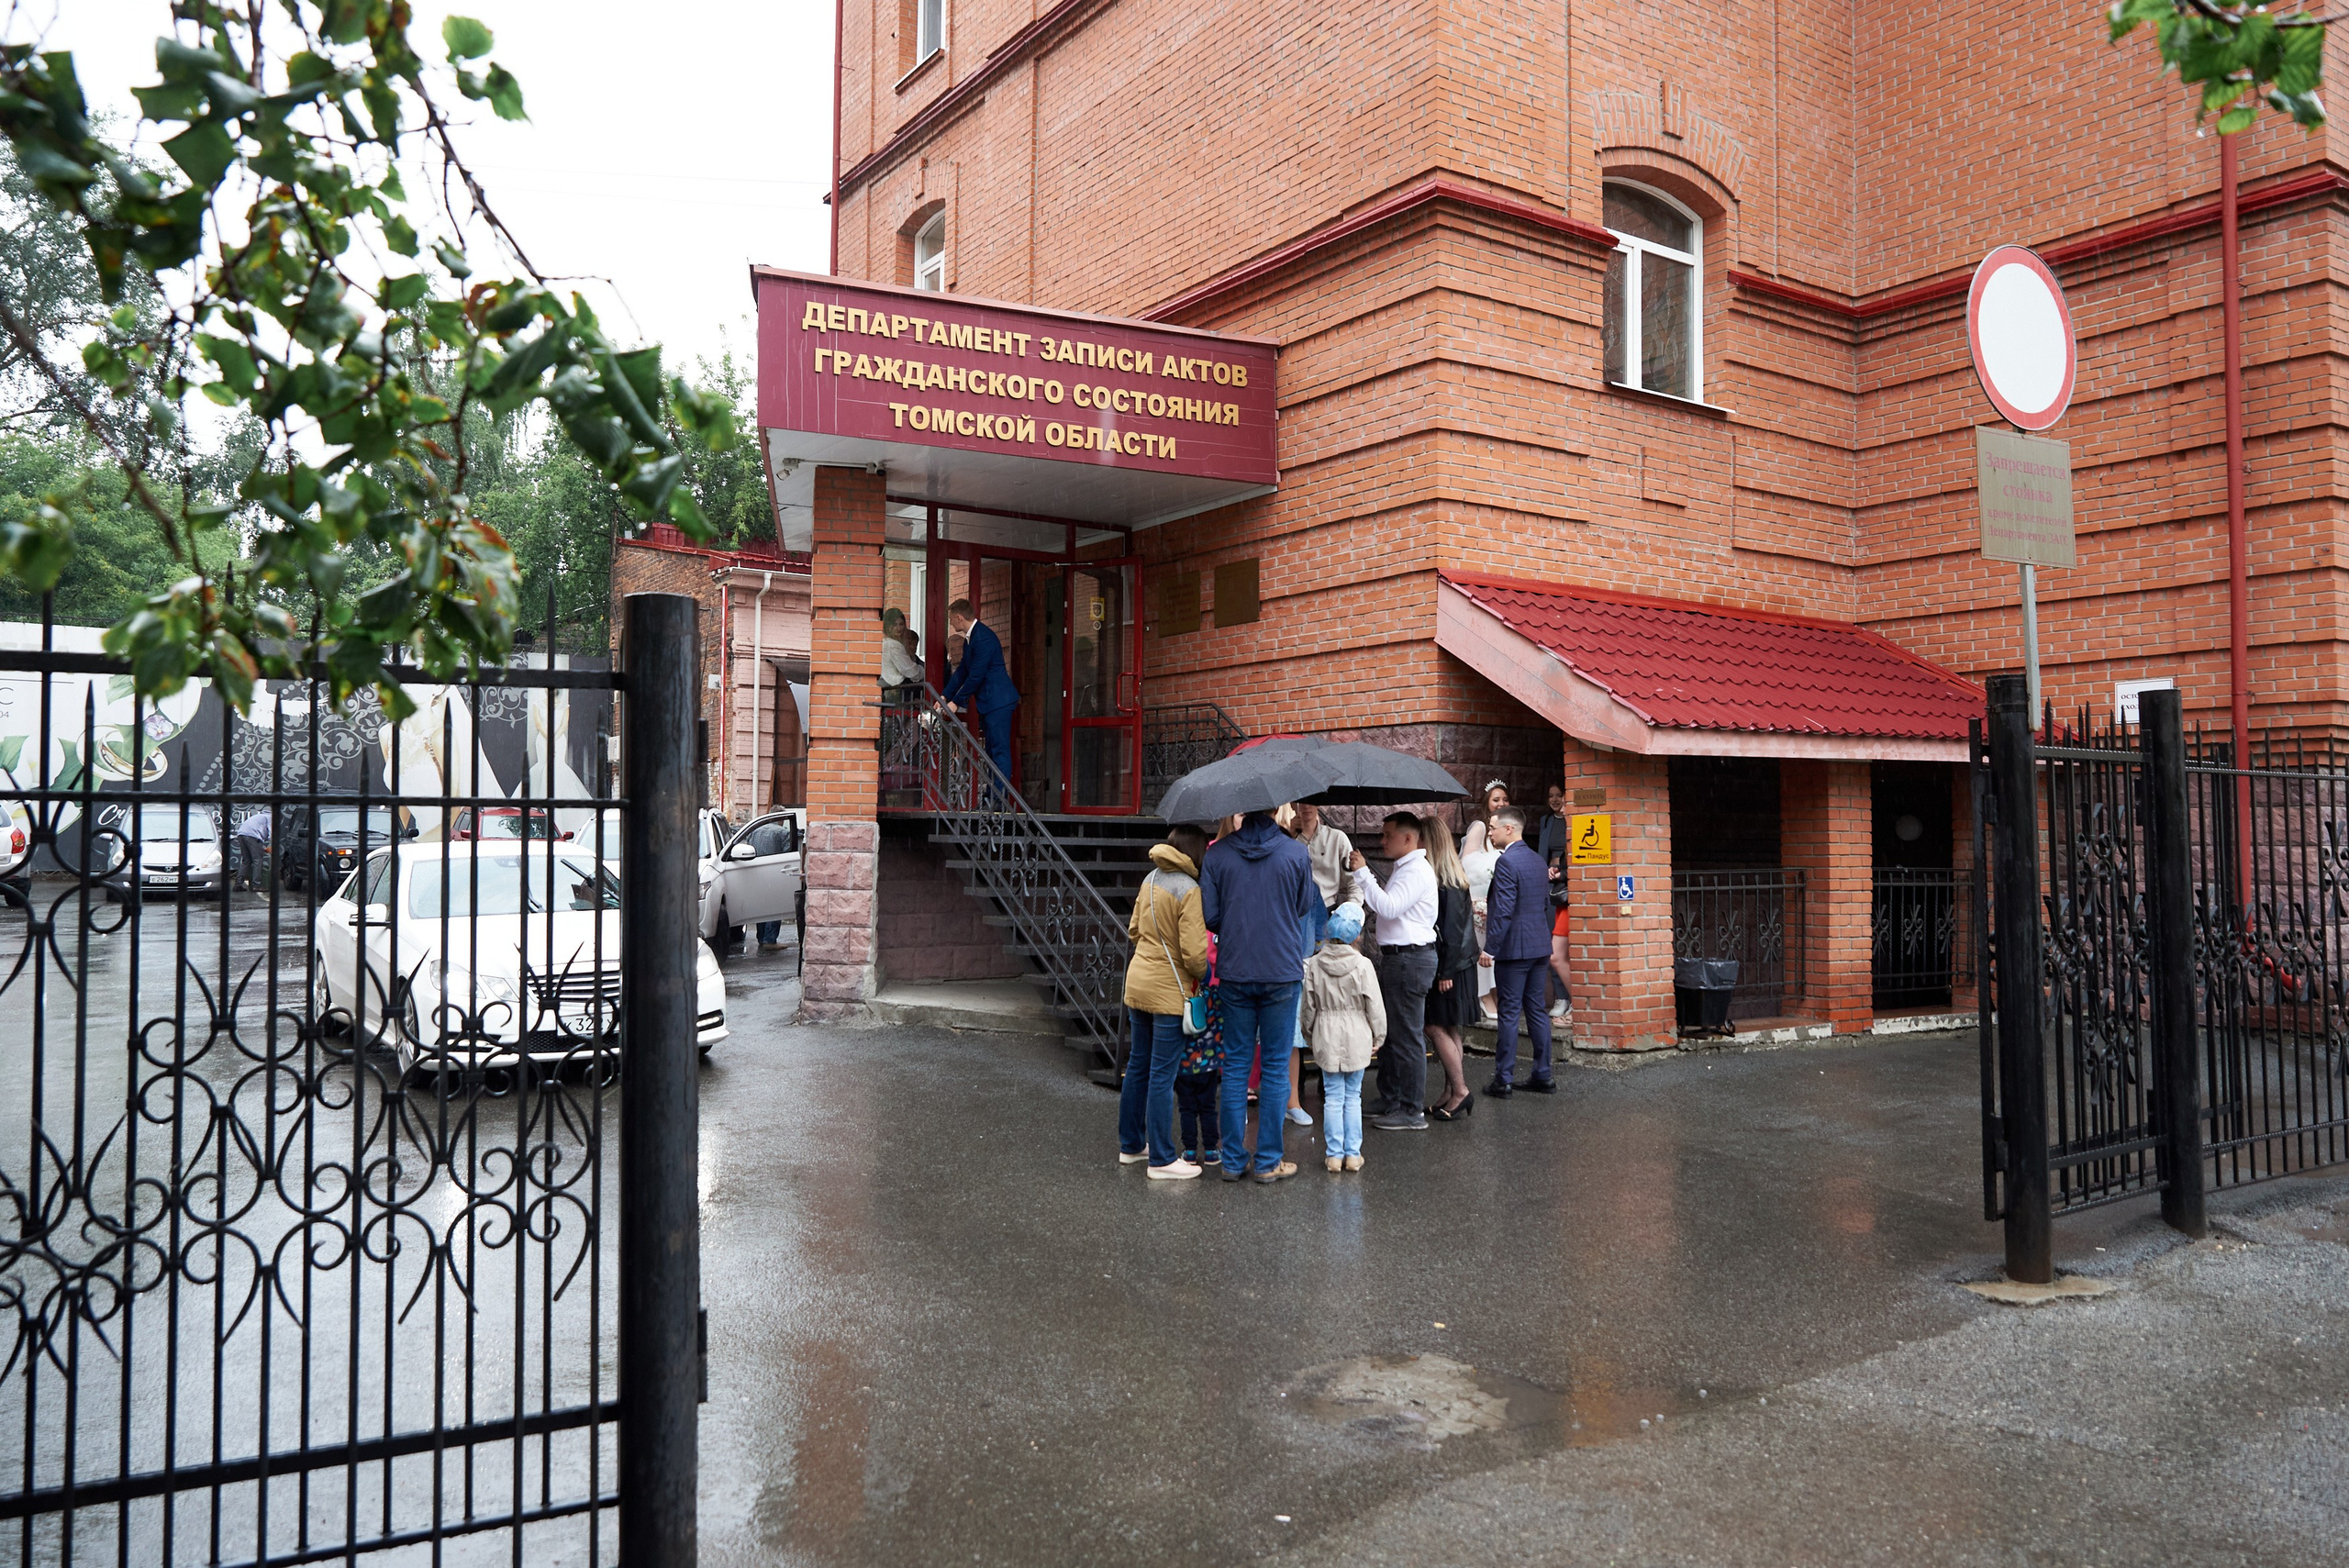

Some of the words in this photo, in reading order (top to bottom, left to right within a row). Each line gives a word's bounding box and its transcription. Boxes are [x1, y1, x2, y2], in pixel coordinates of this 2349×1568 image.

[802, 301, 1031, 357] ДЕПАРТАМЕНТ
[1040, 337, 1153, 375] ЗАПИСИ
[1161, 355, 1249, 387] АКТОВ
[814, 348, 1064, 404] ГРАЖДАНСКОГО
[1073, 384, 1240, 427] СОСТОЯНИЯ
[889, 402, 1036, 443] ТОМСКОЙ
[1045, 422, 1177, 460] ОБЛАСТИ
[1985, 450, 2066, 480] Запрещается
